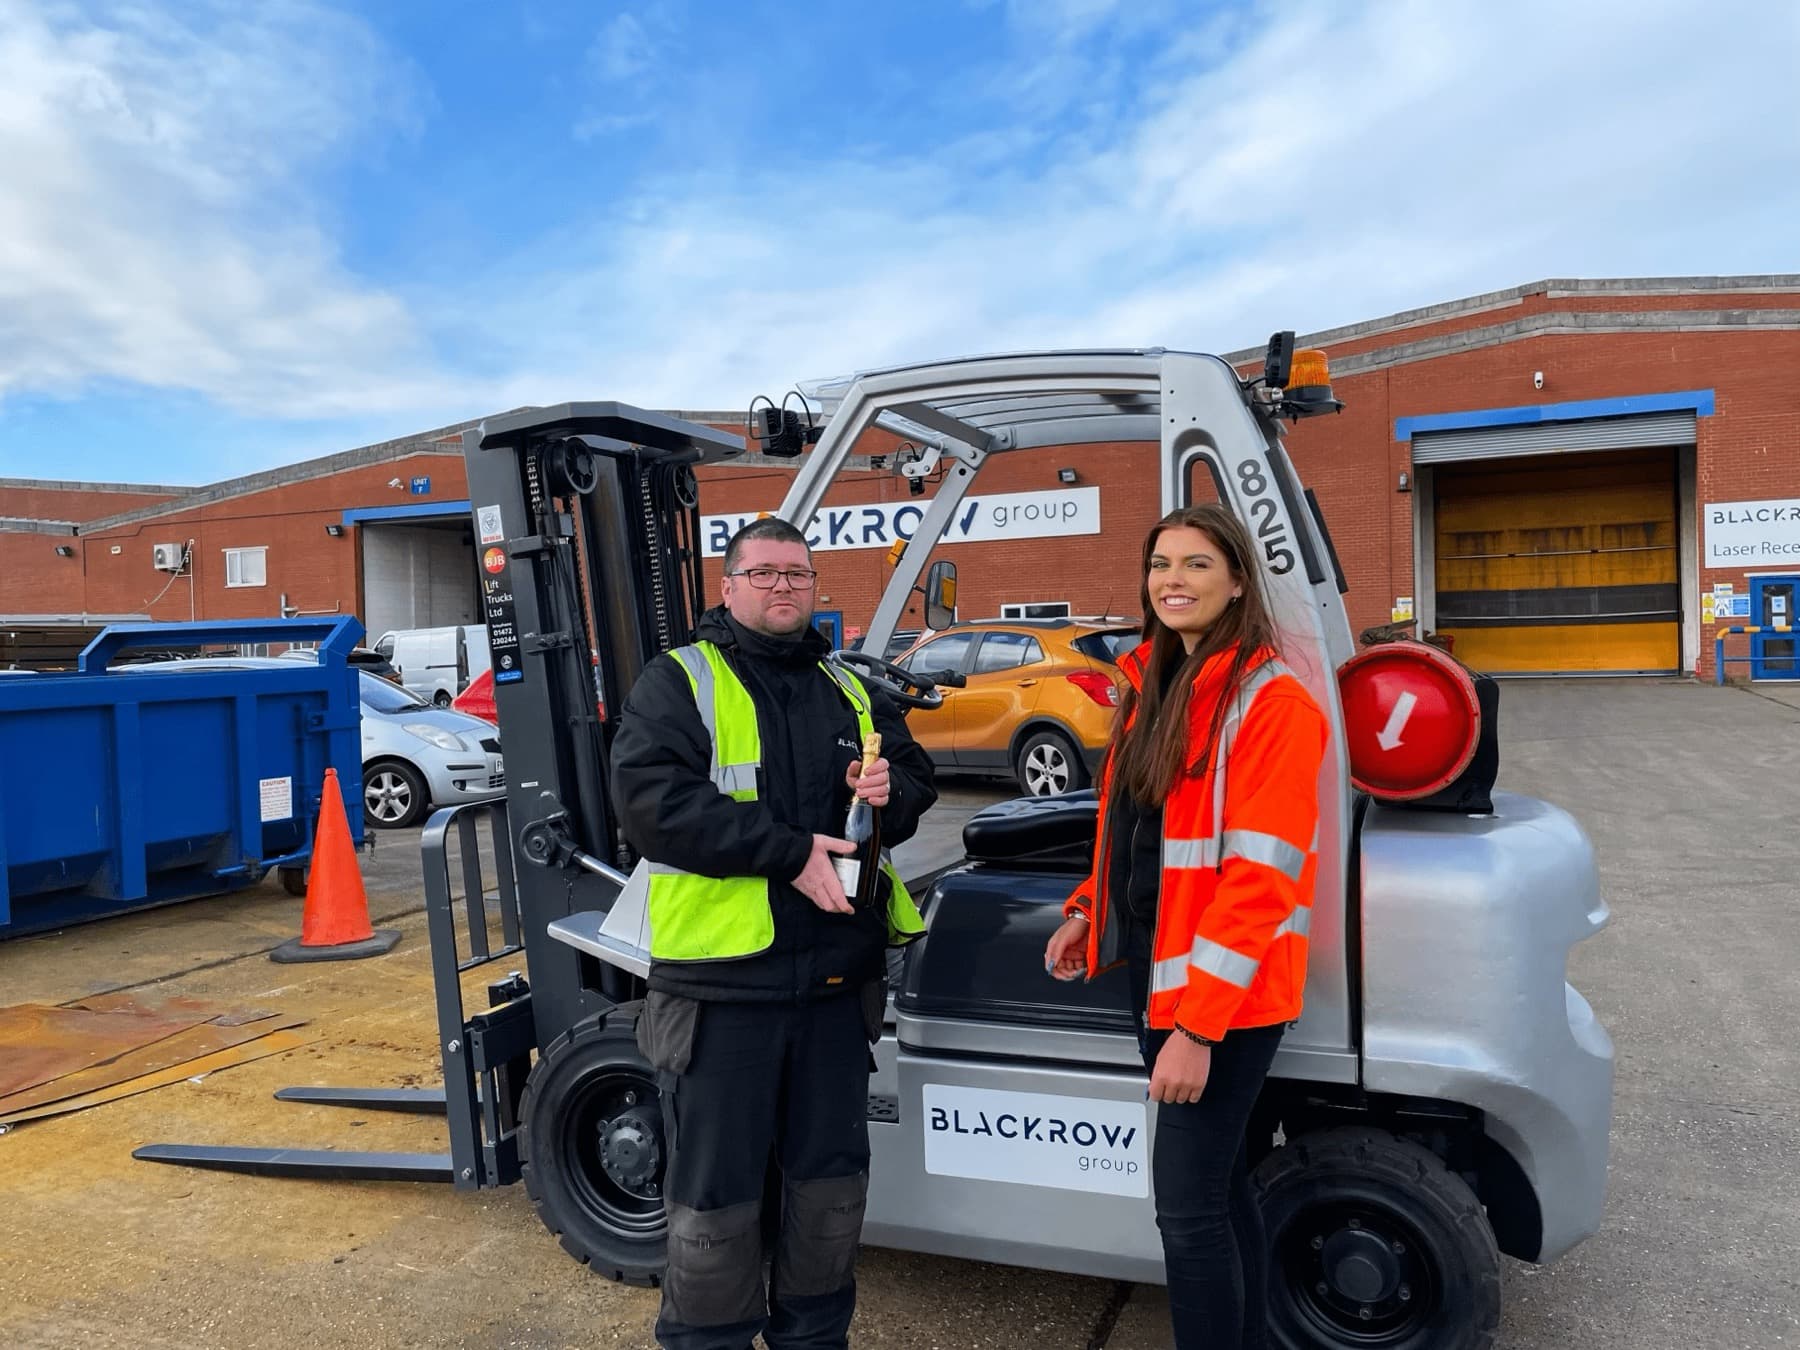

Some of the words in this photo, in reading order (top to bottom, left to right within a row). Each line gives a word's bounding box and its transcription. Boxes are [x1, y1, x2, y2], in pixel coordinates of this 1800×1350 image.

[1237, 459, 1295, 575] 825
[710, 501, 979, 552] BKRO
[993, 501, 1078, 528] group
[1713, 543, 1756, 556] Laser
[1761, 541, 1800, 554] Rece
[486, 555, 505, 567] BJB
[484, 579, 499, 594] Lift
[486, 593, 513, 604] Trucks
[489, 608, 503, 617] Ltd
[931, 1107, 1136, 1149] BLACKROW
[1078, 1156, 1138, 1175] group
